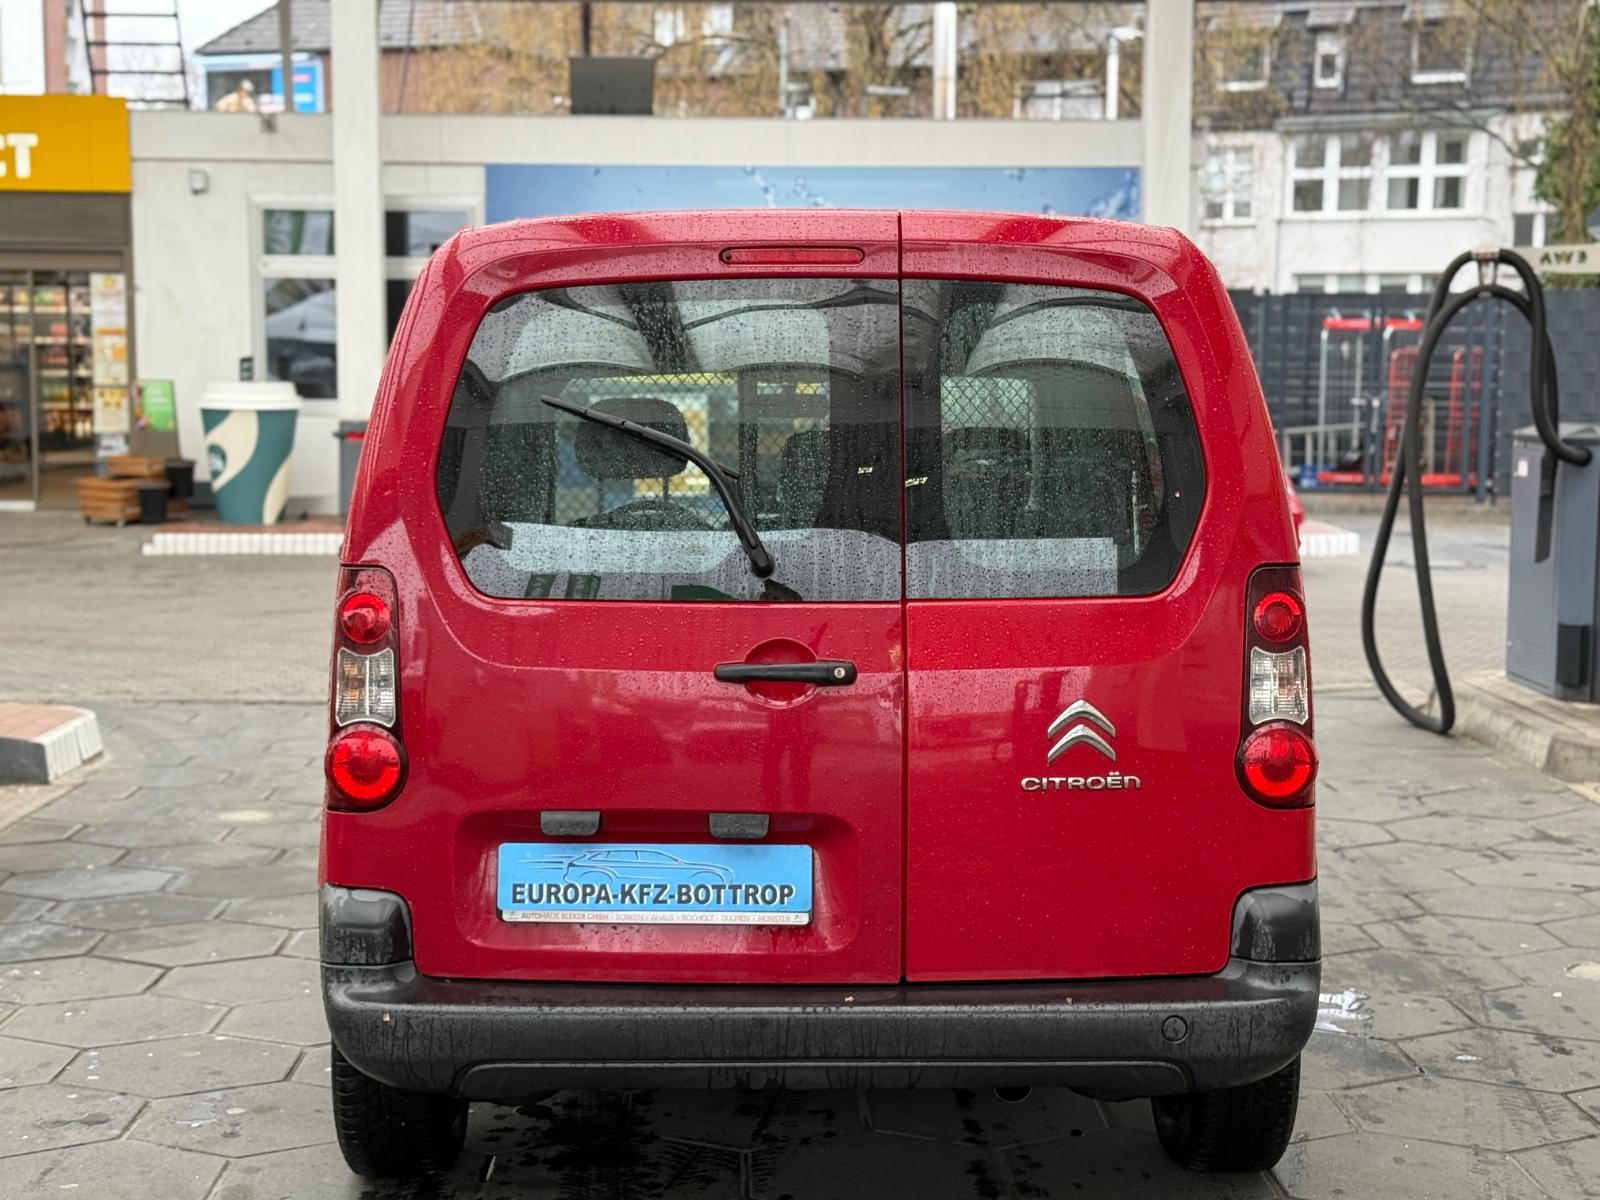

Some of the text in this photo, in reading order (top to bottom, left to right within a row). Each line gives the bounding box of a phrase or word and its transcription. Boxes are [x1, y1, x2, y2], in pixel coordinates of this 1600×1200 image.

[0, 133, 39, 180] T
[511, 882, 796, 906] EUROPA-KFZ-BOTTROP
[520, 911, 560, 921] AUTOHAUS
